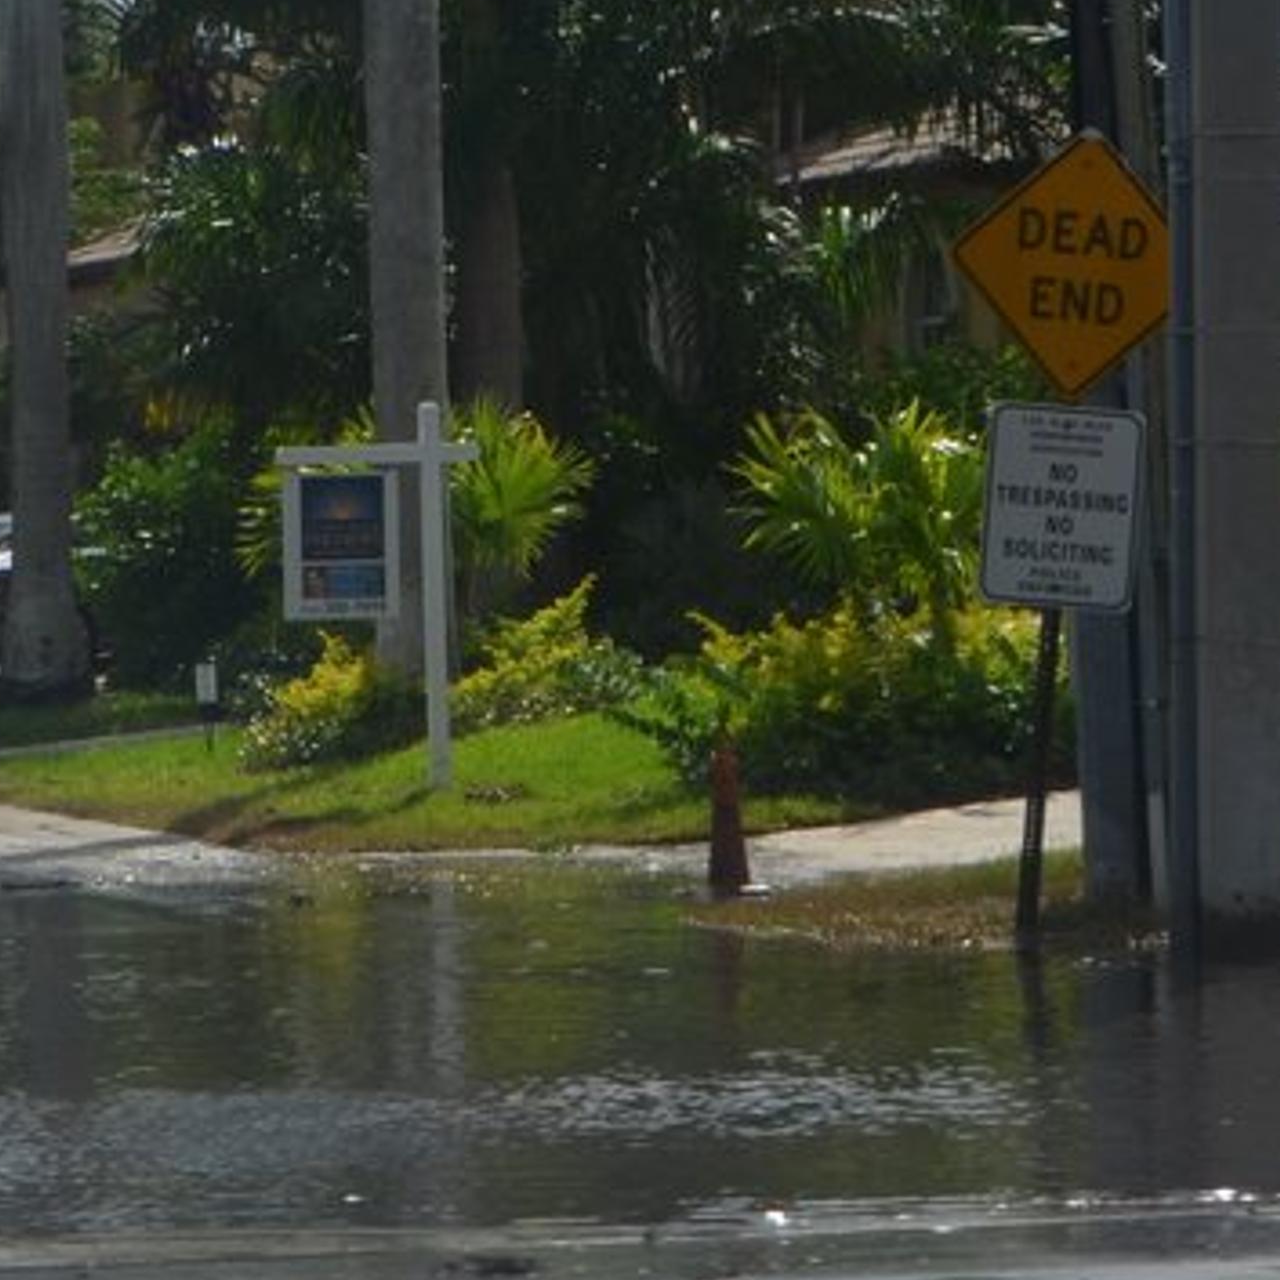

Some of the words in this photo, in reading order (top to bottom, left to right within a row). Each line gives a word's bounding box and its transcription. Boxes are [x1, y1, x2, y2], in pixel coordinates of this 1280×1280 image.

[1019, 208, 1149, 259] DEAD
[1030, 276, 1125, 326] END
[1049, 463, 1079, 484] NO
[997, 484, 1129, 515] TRESPASSING
[1045, 516, 1074, 535] NO
[1003, 538, 1114, 567] SOLICITING
